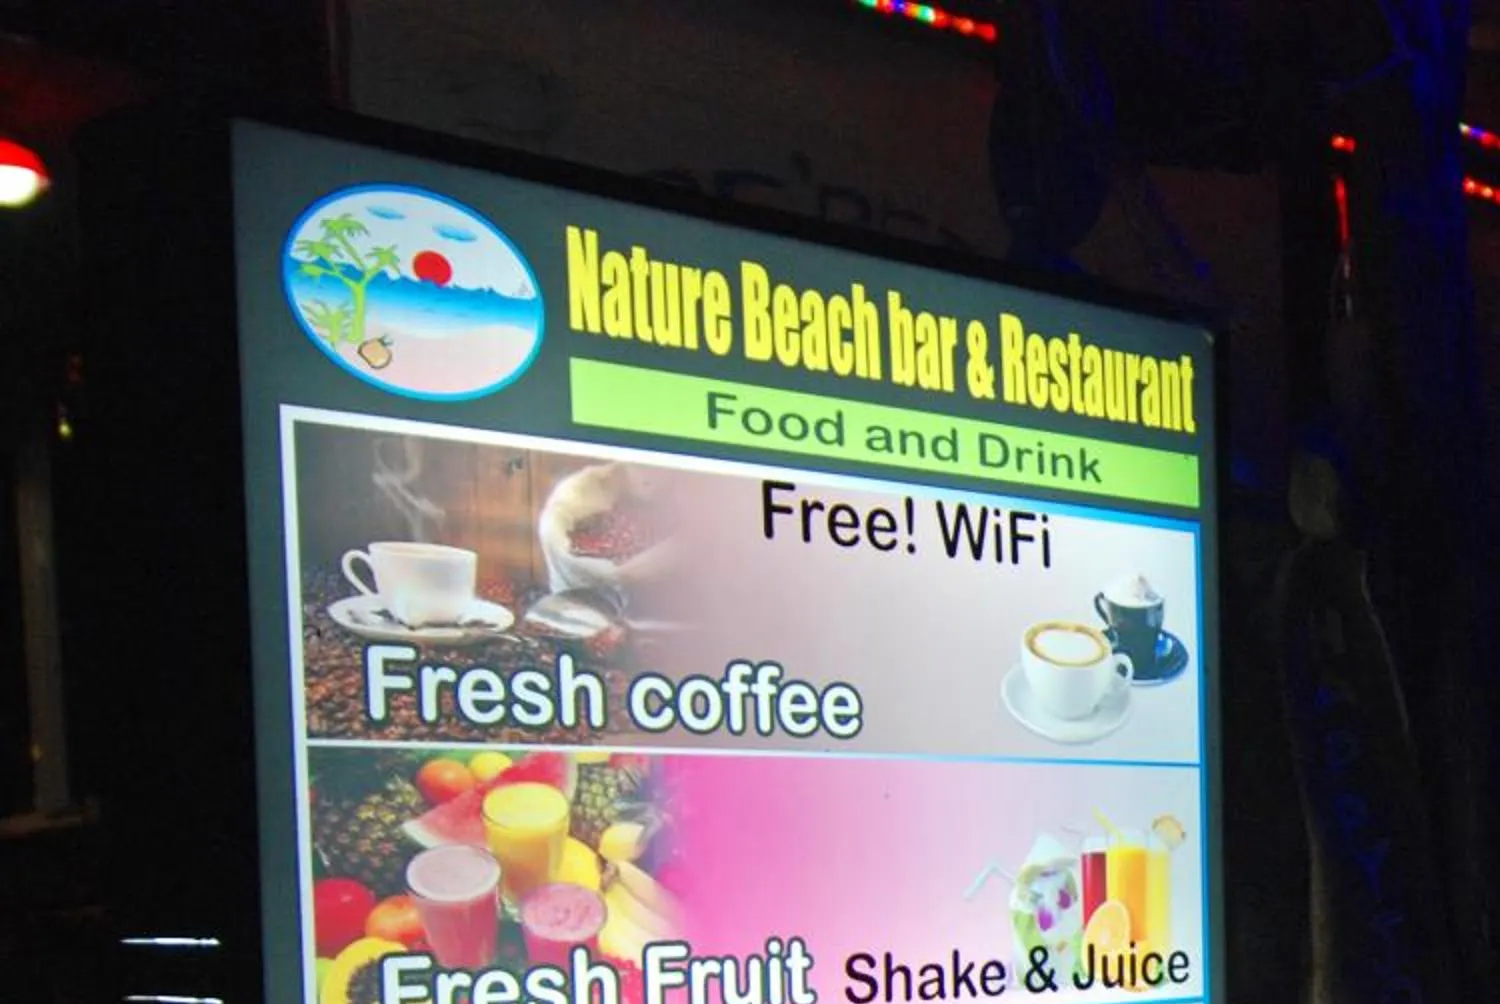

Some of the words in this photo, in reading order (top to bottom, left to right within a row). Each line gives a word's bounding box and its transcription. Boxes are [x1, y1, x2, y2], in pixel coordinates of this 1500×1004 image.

[566, 226, 732, 354] Nature
[740, 262, 880, 381] Beach
[888, 290, 957, 395] bar
[967, 320, 994, 398] &
[1000, 314, 1197, 433] Restaurant
[706, 391, 846, 448] Food
[864, 416, 959, 463] and
[978, 433, 1102, 484] Drink
[761, 480, 916, 556] Free!
[937, 503, 1052, 569] WiFi
[361, 645, 605, 731] Fresh
[628, 661, 863, 739] coffee
[844, 949, 1006, 1004] Shake
[1024, 946, 1057, 992] &
[1073, 943, 1190, 990] Juice
